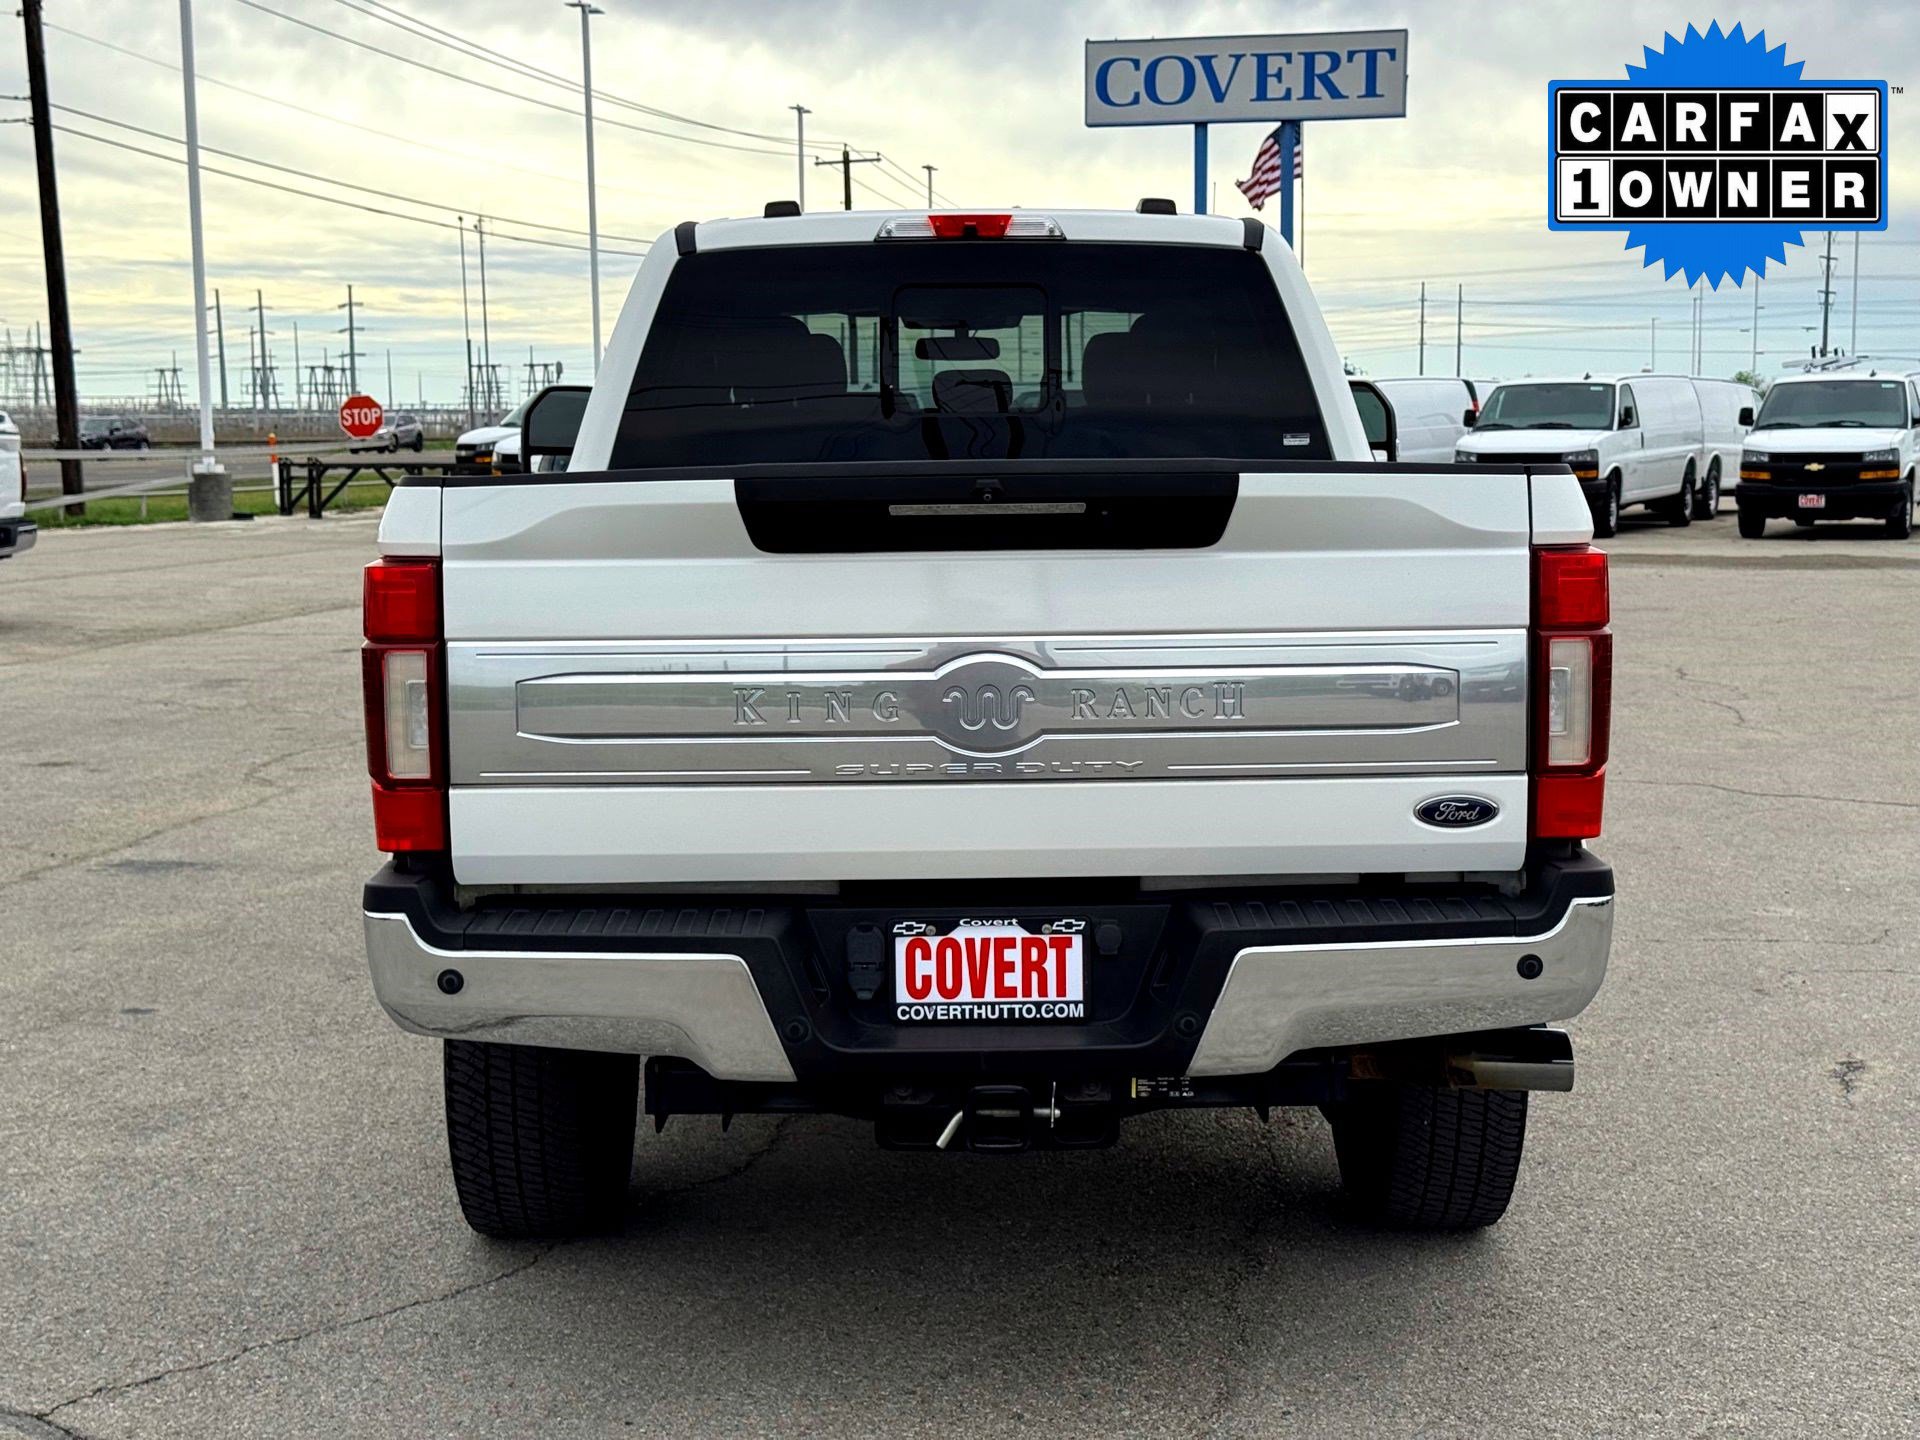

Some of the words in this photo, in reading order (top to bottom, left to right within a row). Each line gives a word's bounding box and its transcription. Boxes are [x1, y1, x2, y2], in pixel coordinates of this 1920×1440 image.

[1095, 48, 1397, 107] COVERT
[342, 408, 380, 426] STOP
[733, 688, 900, 726] KING
[1071, 681, 1246, 720] RANCH
[835, 762, 1002, 776] SUPER
[1016, 760, 1144, 774] DUTY
[1434, 801, 1481, 820] Ford
[959, 918, 1019, 927] Covert
[905, 936, 1073, 1000] COVERT
[897, 1003, 1084, 1020] COVERTHUTTO.COM
